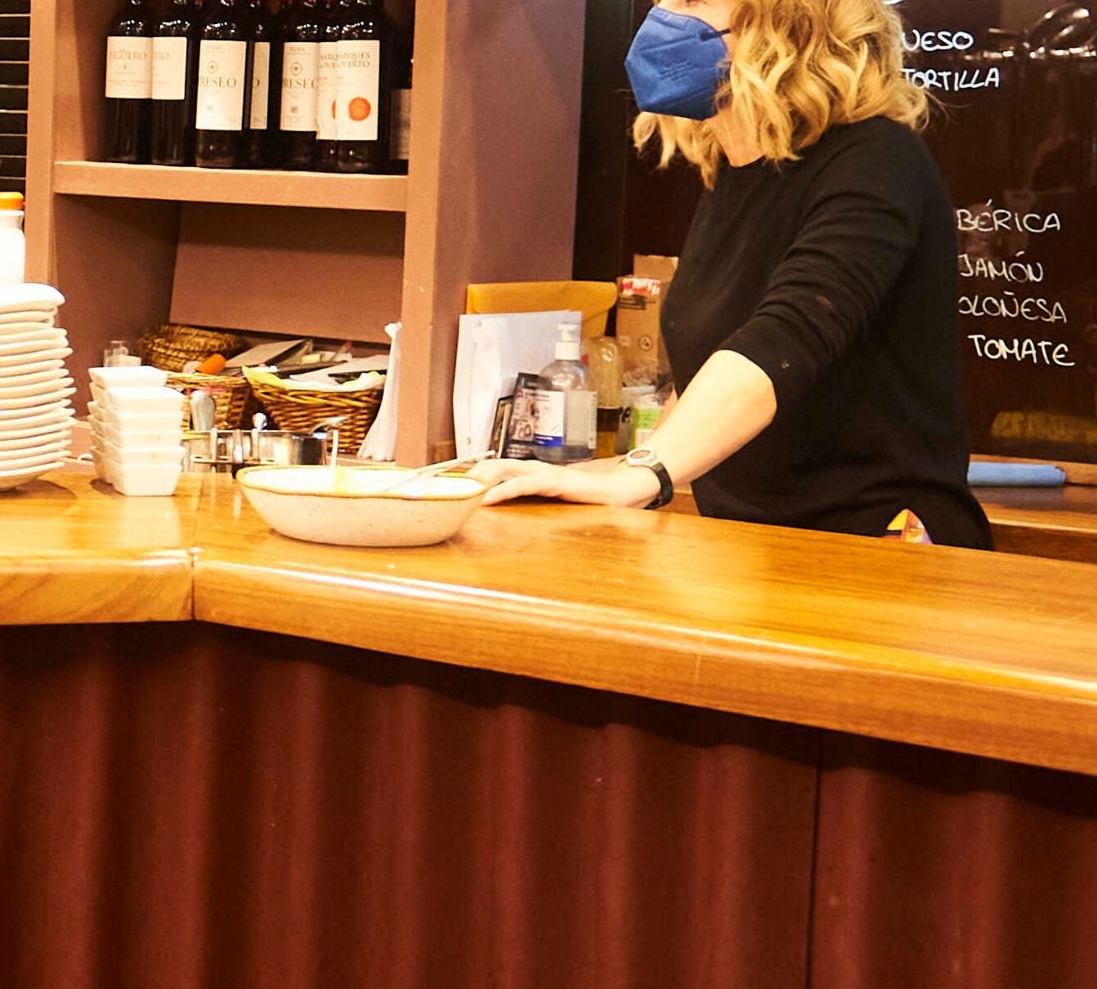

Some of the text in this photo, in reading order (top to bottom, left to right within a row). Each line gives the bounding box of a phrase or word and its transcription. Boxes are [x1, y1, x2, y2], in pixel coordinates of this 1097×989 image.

[902, 29, 974, 52] UESO
[902, 67, 1000, 92] TORTILLA
[956, 199, 1061, 233] BÉRICA
[958, 251, 1044, 282] JAMÓN
[958, 291, 1067, 324] OLOÑESA
[967, 334, 1076, 366] TOMATE
